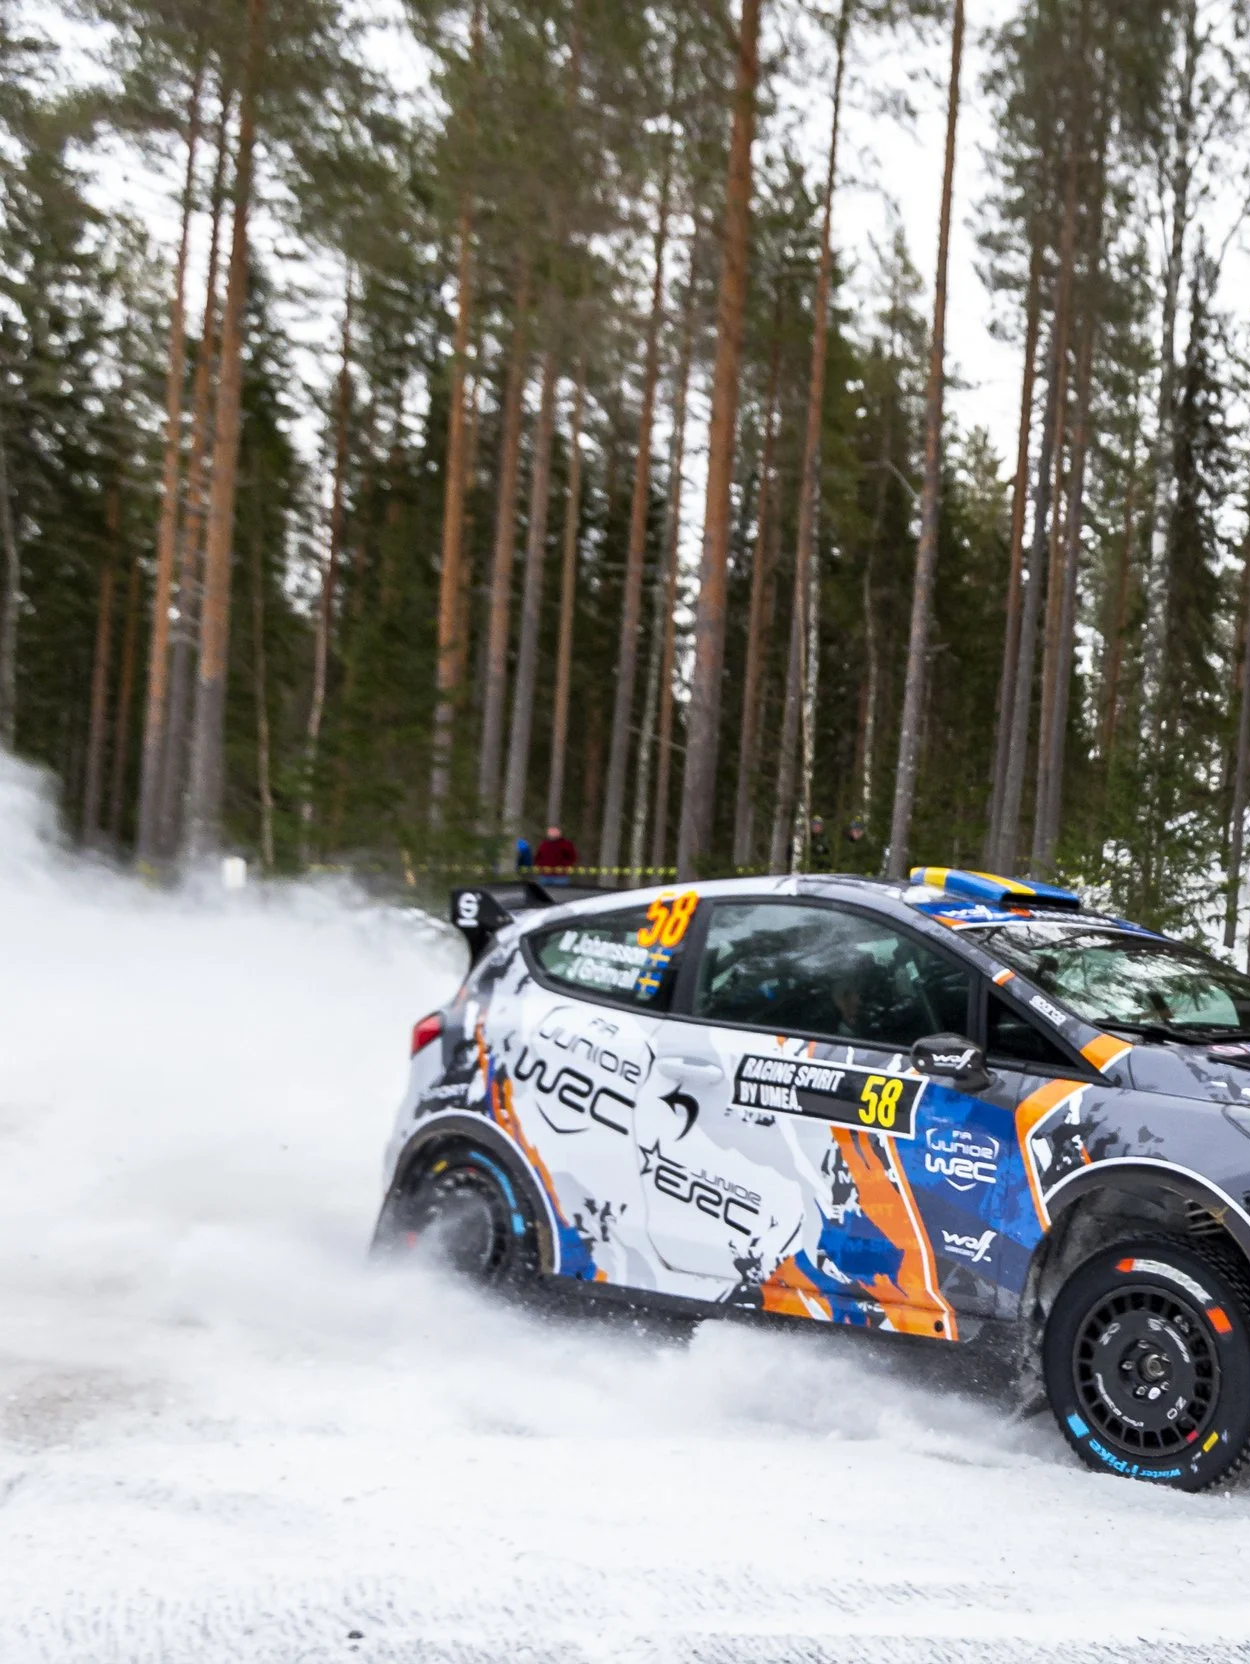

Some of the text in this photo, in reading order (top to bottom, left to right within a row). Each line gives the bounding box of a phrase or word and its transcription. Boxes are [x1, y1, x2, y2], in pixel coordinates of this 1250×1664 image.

[637, 890, 699, 948] 58
[514, 1046, 636, 1135] WRC
[739, 1081, 757, 1104] BY
[742, 1057, 845, 1092] RACING SPIRIT
[858, 1075, 904, 1128] 58
[925, 1153, 997, 1184] WRC
[931, 1140, 994, 1160] JUNIOR
[690, 1168, 762, 1207] JUNIOR
